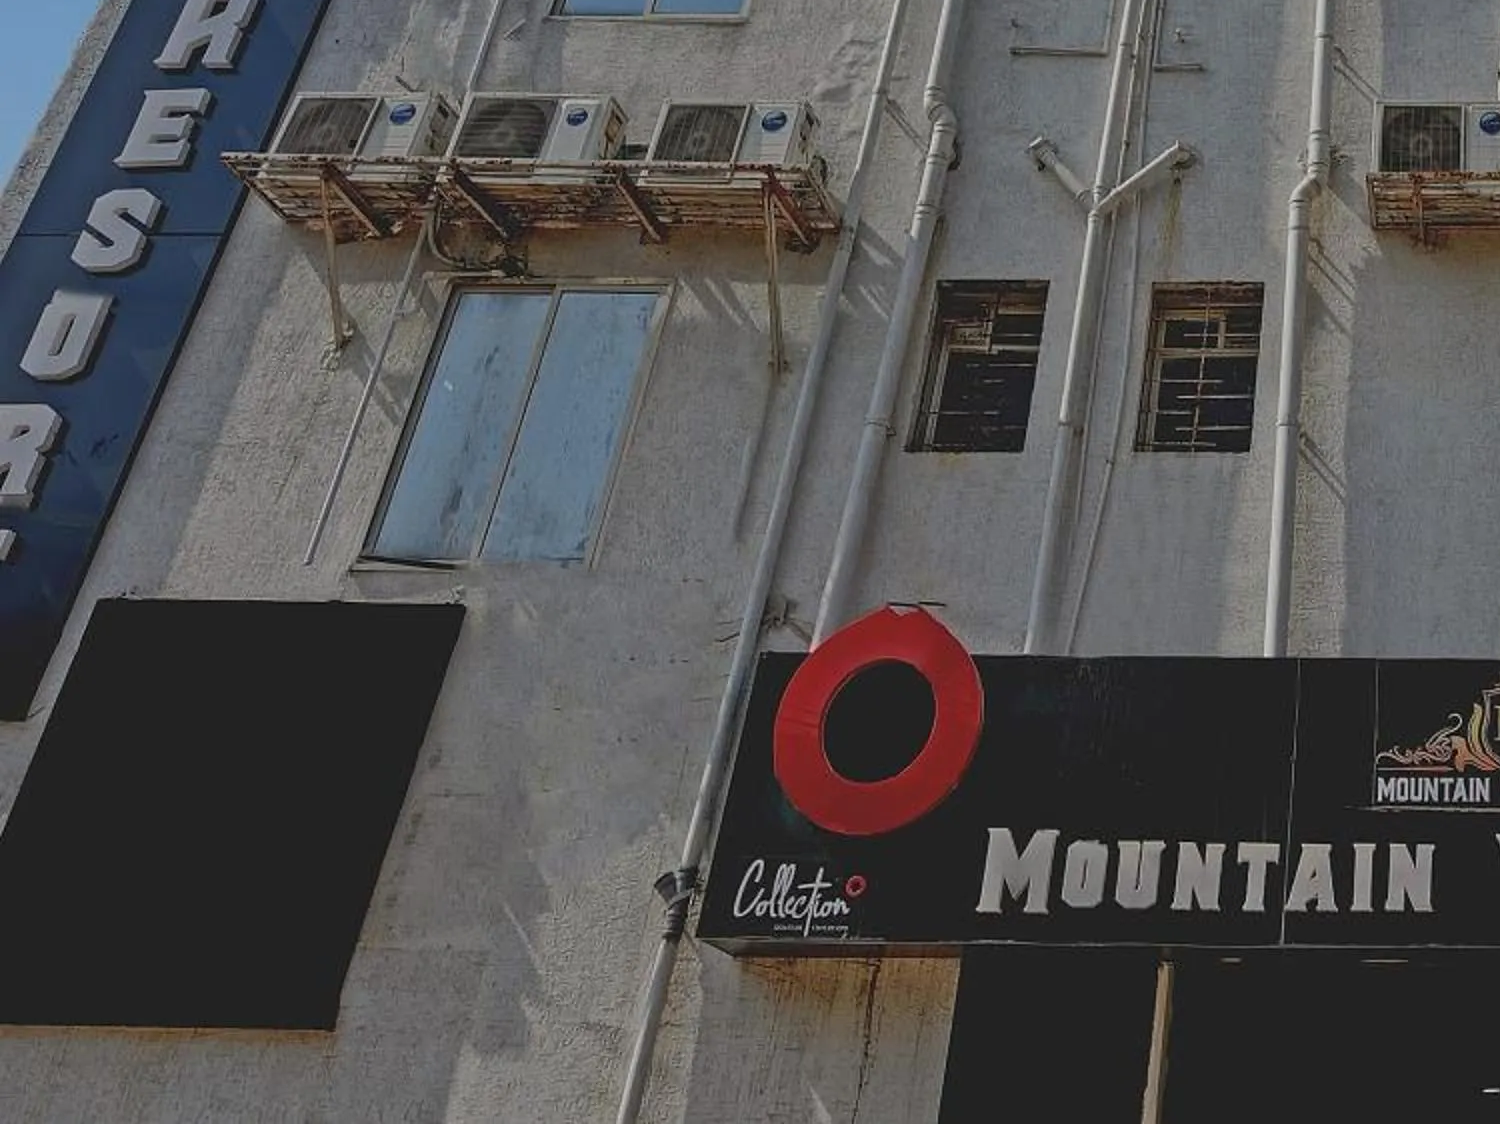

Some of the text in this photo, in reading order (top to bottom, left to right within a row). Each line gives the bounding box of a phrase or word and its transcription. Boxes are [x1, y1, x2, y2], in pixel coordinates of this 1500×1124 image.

[1377, 777, 1492, 803] MOUNTAIN
[733, 859, 850, 938] Collection
[975, 827, 1437, 915] MOUNTAIN
